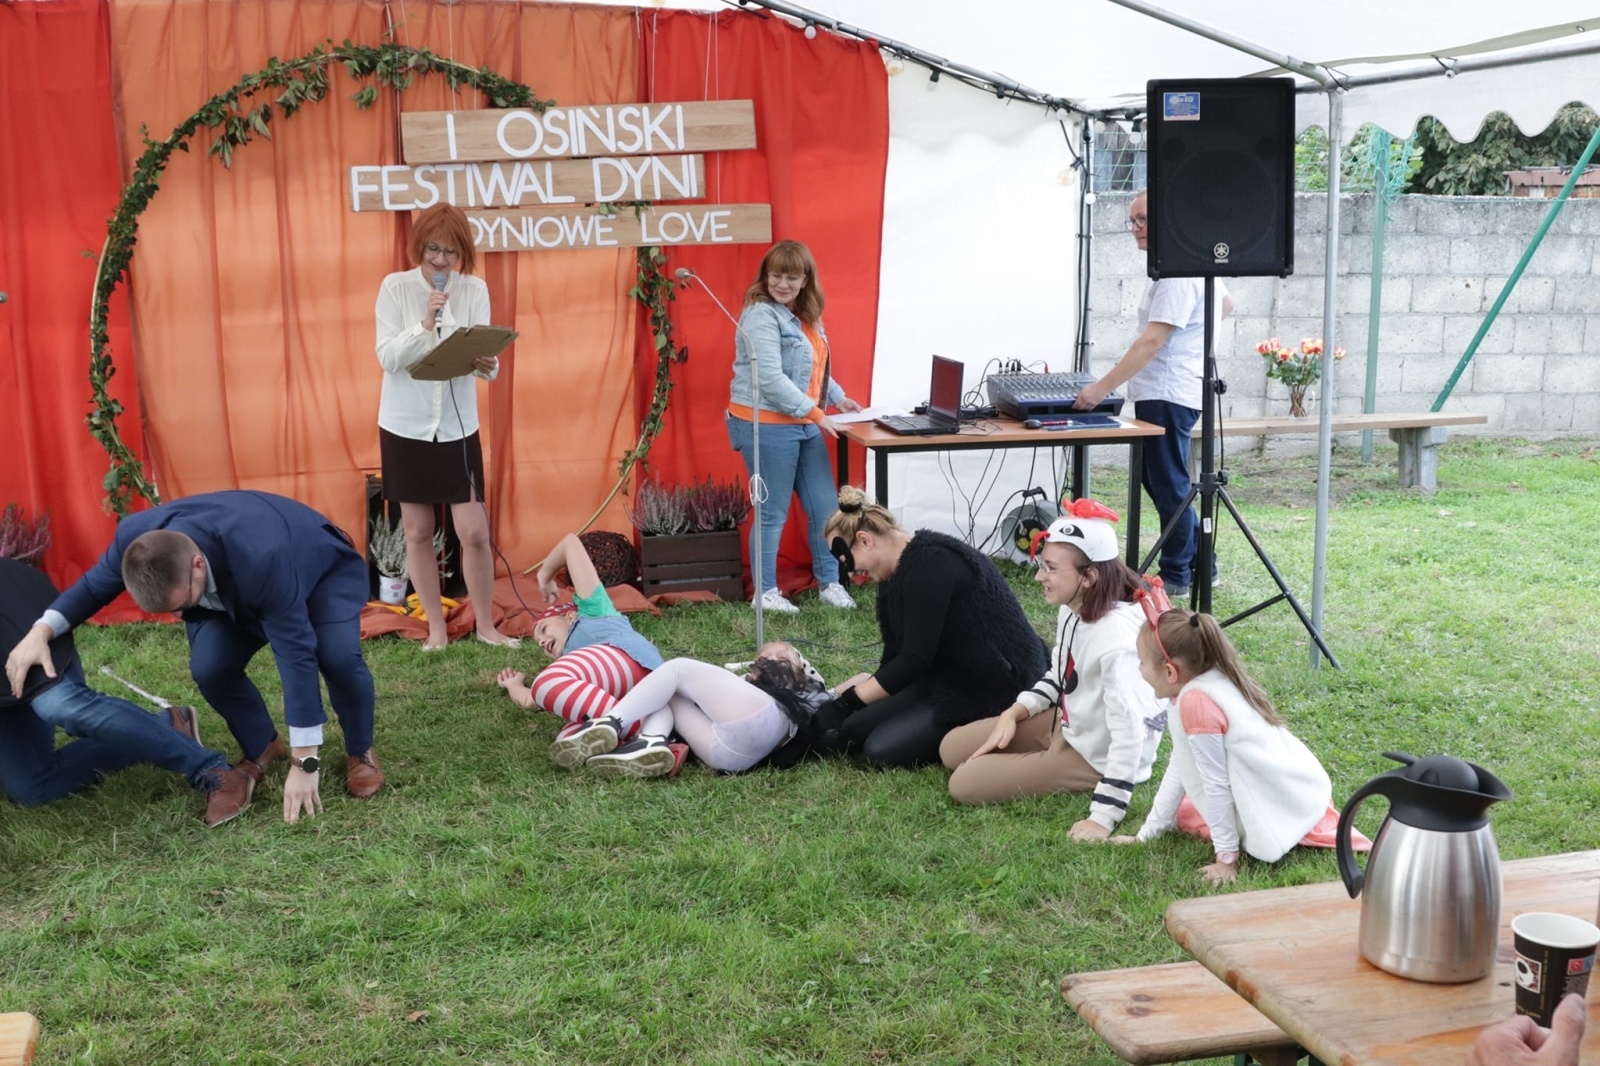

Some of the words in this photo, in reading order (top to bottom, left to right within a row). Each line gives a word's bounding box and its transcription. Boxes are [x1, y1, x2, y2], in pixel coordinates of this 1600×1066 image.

[446, 113, 458, 160] I
[350, 162, 576, 212] FESTIWAL
[592, 154, 698, 204] DYNI
[640, 210, 733, 244] LOVE
